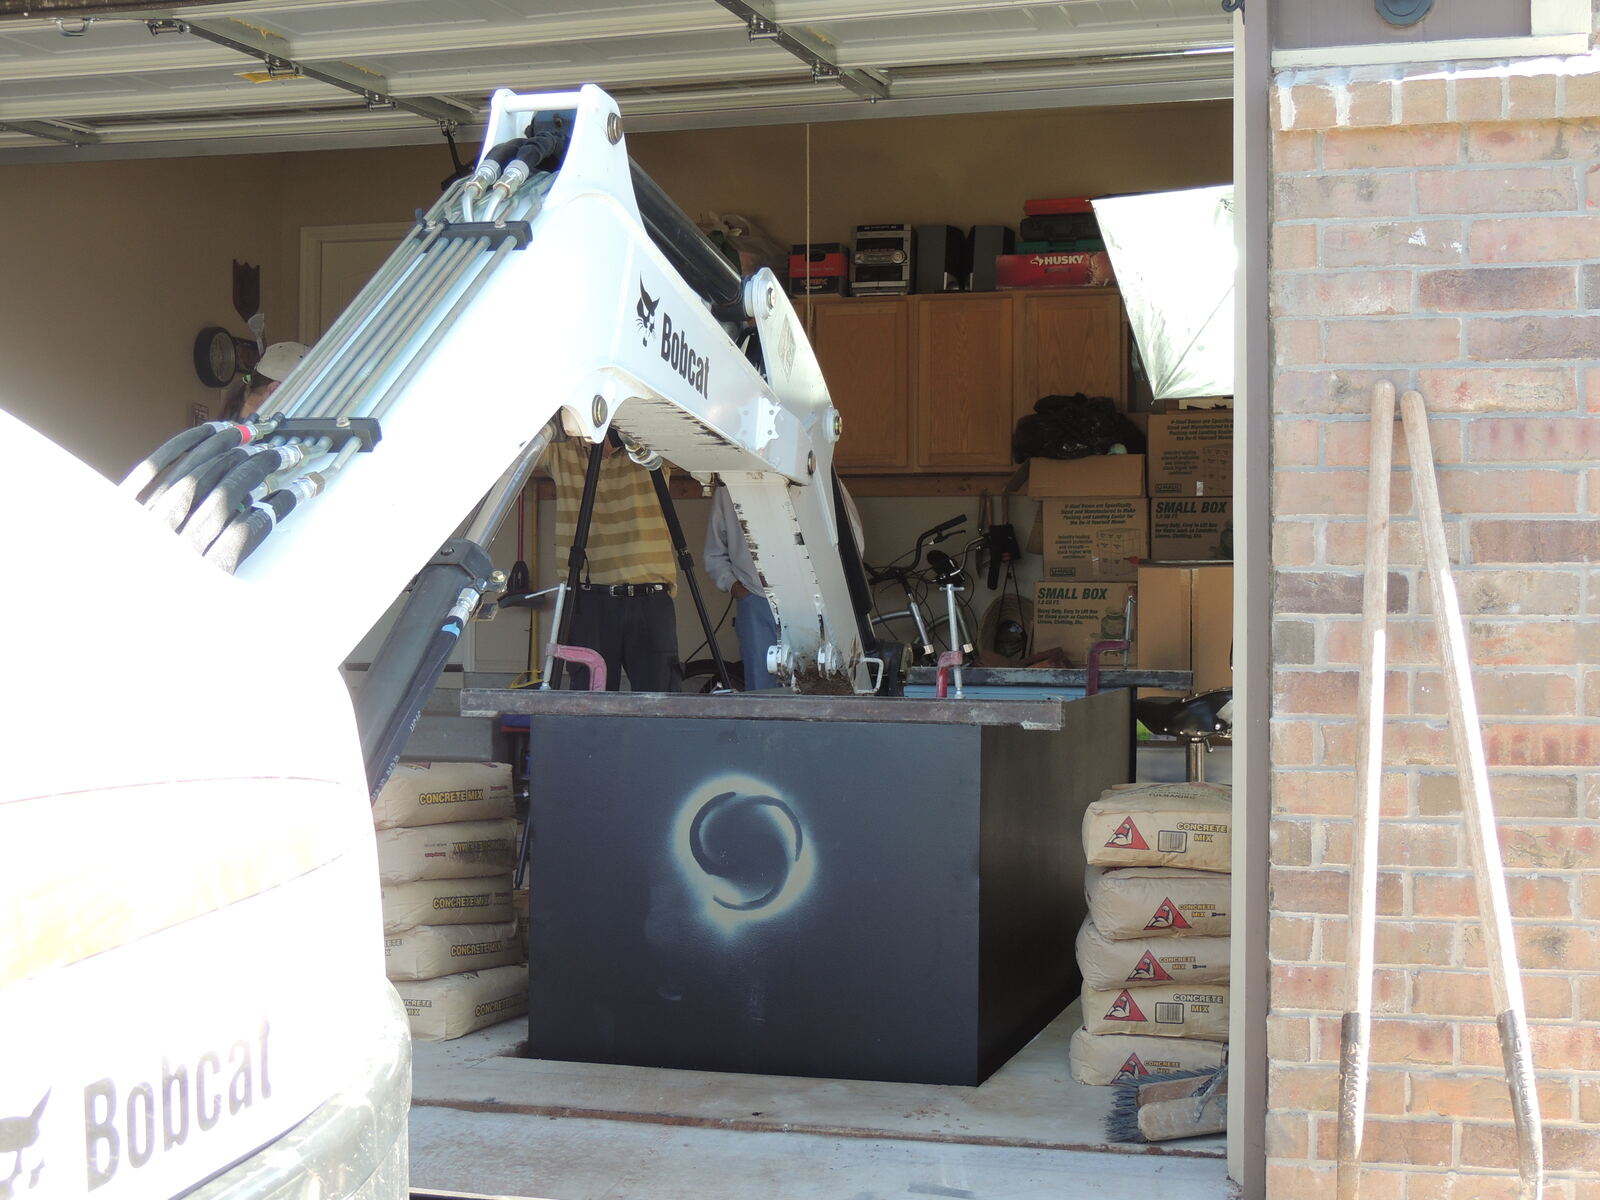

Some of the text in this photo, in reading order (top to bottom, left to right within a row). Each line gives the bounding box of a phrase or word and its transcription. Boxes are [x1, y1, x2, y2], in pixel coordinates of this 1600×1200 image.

[1044, 255, 1083, 265] HUSKY
[661, 312, 709, 400] Bobcat
[1156, 502, 1226, 513] SMALL BOX
[1037, 588, 1107, 600] SMALL BOX
[419, 789, 484, 805] CONCRETE MIX
[1177, 822, 1227, 833] CONCRETE
[1194, 833, 1214, 842] MIX
[433, 896, 474, 909] CONCRETE
[451, 942, 488, 957] CONCRETE
[1173, 993, 1223, 1004] CONCRETE
[1191, 1004, 1210, 1014] MIX
[83, 1013, 272, 1192] Bobcat
